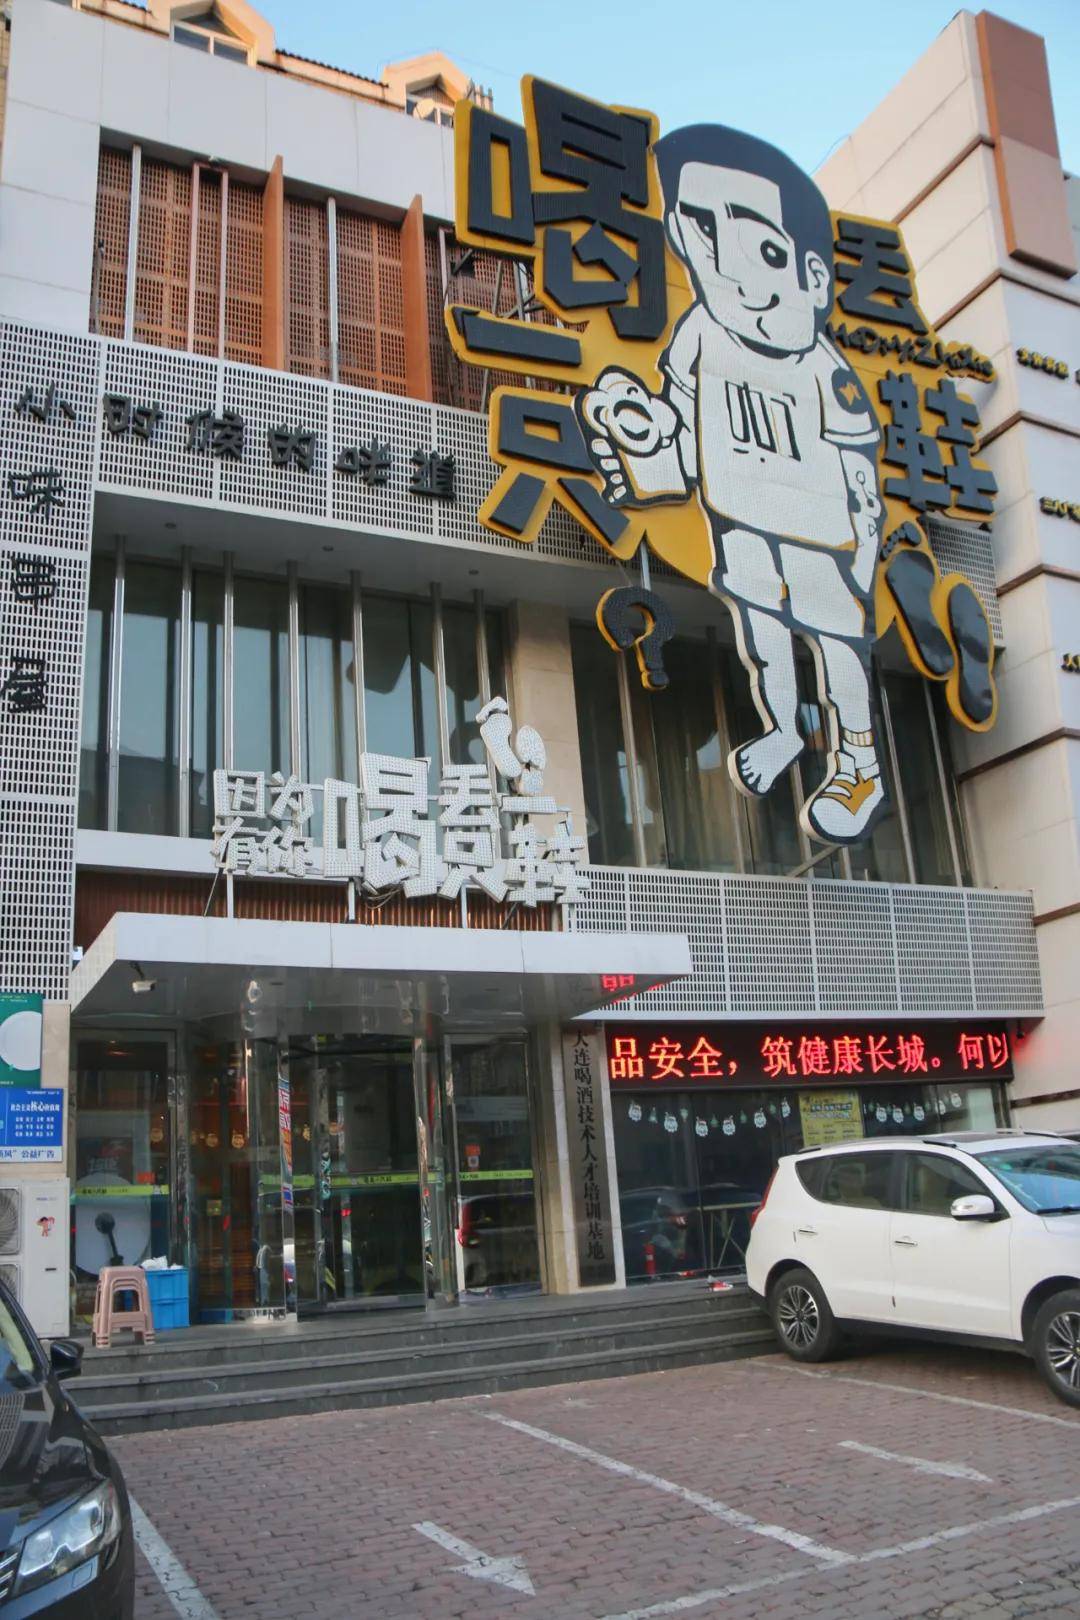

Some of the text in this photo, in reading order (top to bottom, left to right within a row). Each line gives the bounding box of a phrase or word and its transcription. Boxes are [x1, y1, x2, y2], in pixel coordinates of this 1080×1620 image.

[13, 381, 457, 500] 小时候的味道
